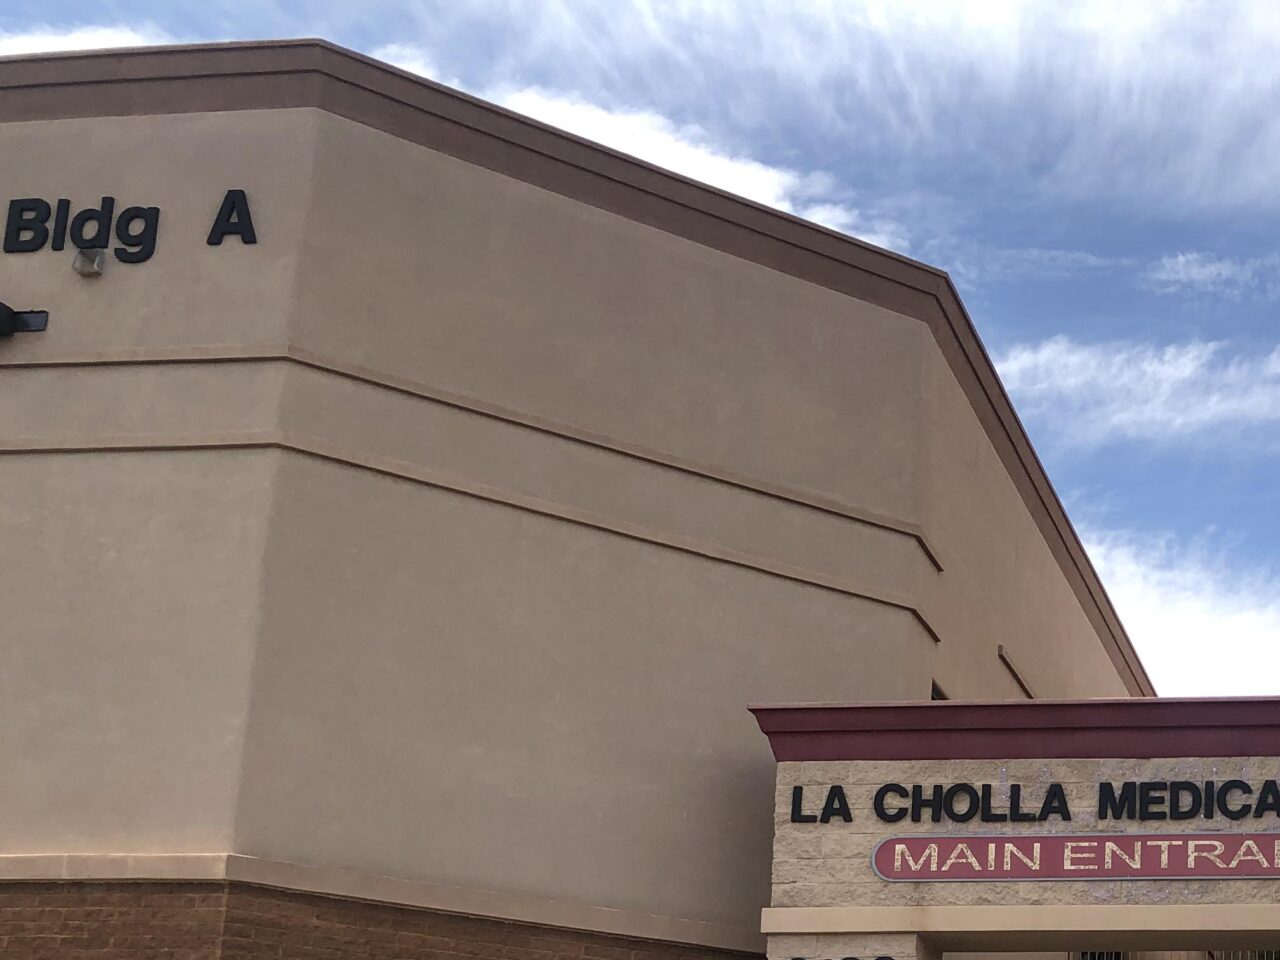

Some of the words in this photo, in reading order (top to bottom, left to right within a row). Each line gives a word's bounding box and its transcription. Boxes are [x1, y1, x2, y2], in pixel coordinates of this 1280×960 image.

[3, 197, 160, 263] Bldg
[207, 189, 257, 246] A
[790, 784, 853, 824] LA
[873, 781, 1071, 823] CHOLLA
[893, 841, 1041, 872] MAIN
